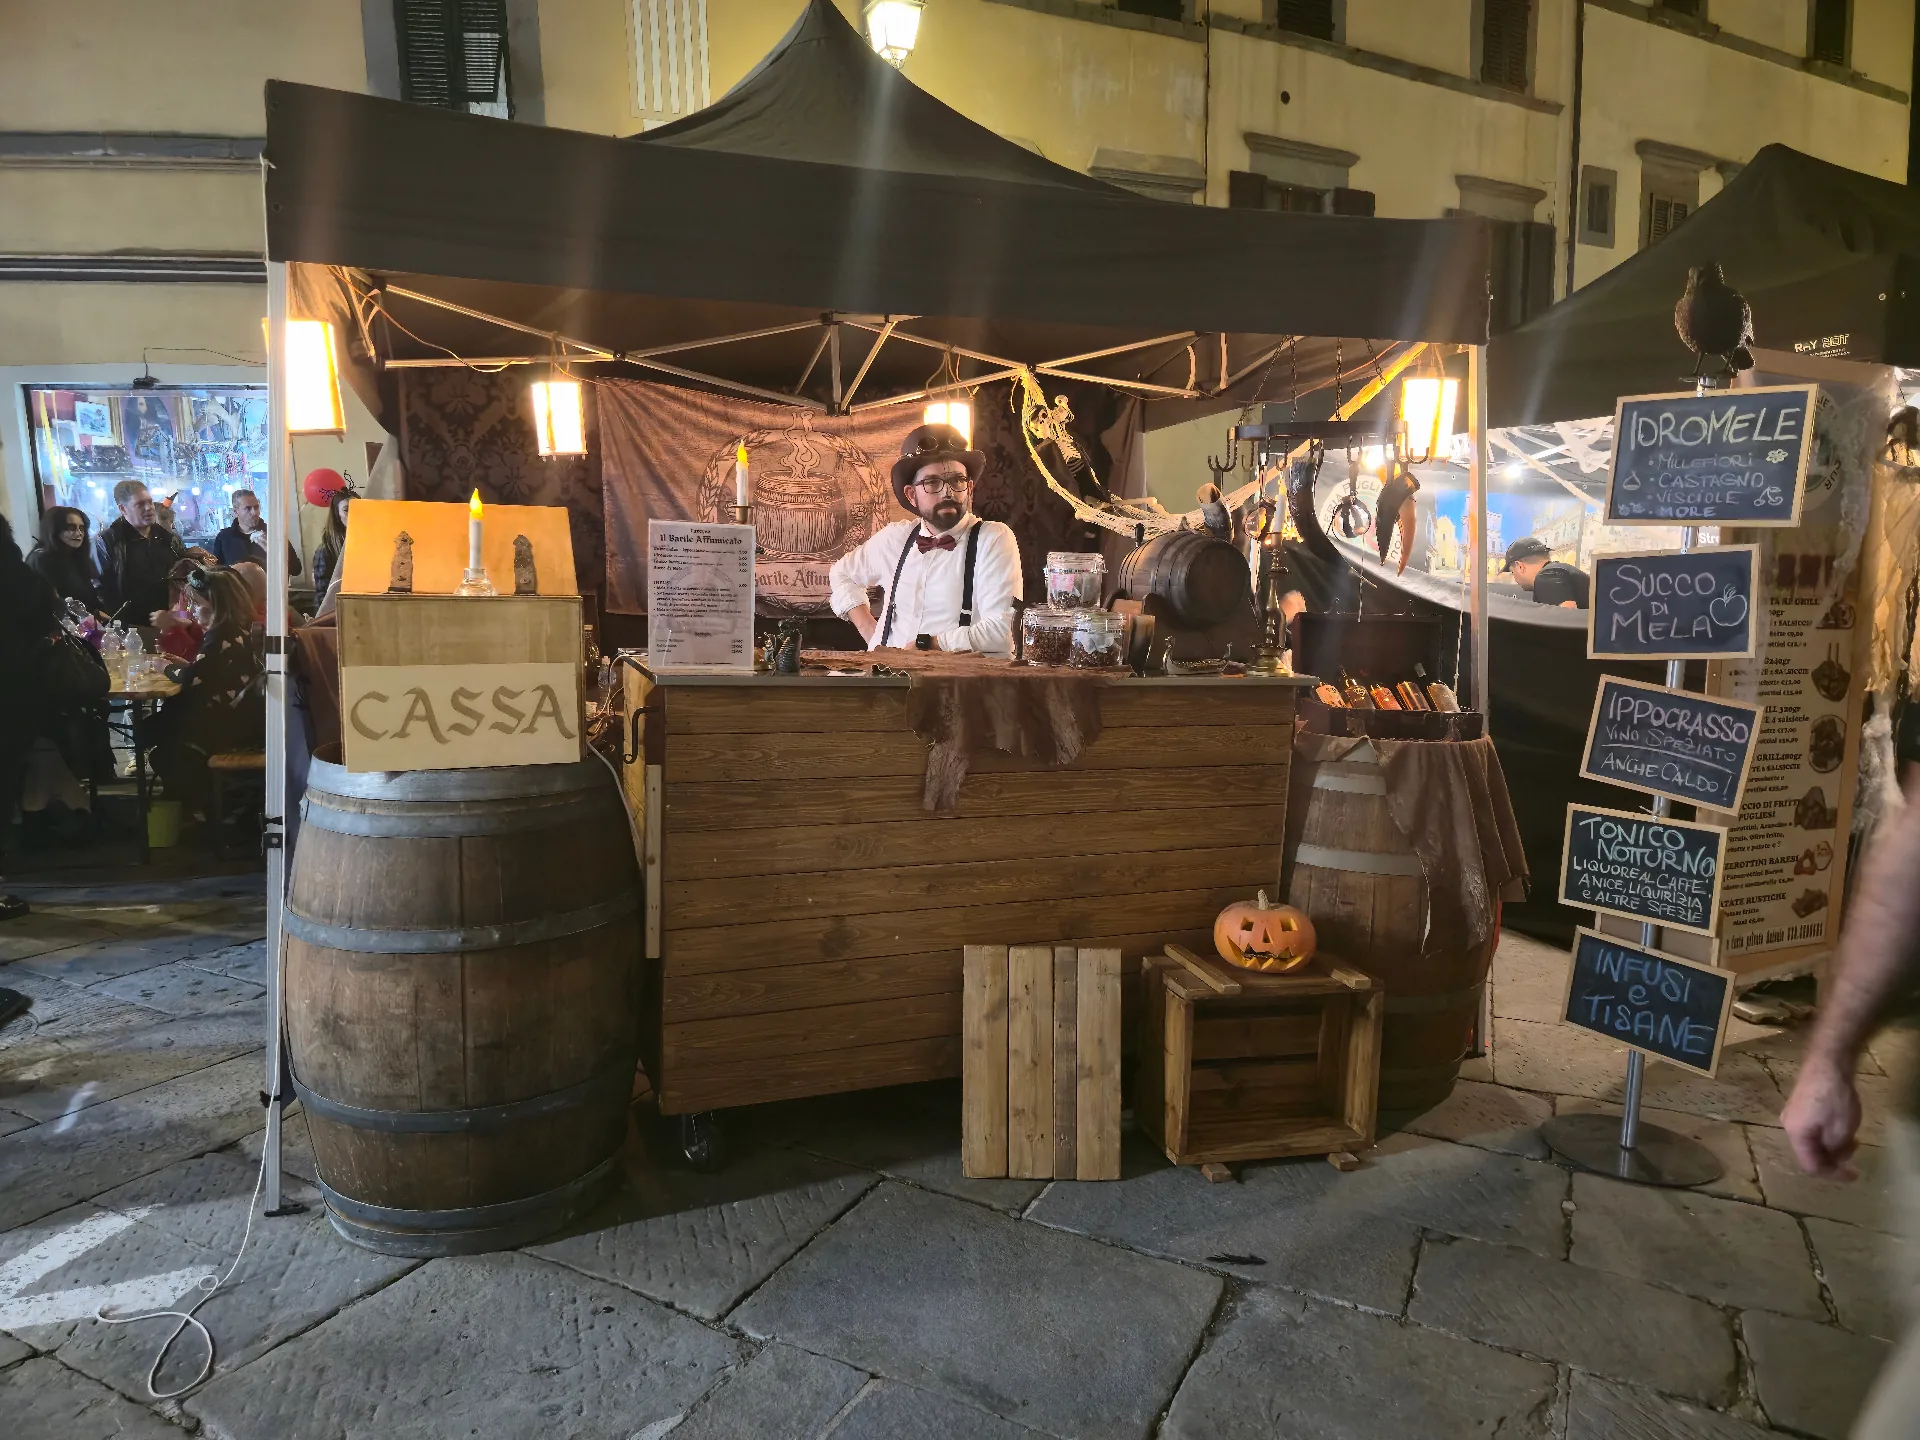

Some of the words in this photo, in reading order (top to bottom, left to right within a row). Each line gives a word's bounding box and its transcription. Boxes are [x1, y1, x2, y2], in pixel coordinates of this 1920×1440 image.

[1630, 405, 1800, 450] IDROMELE
[1659, 472, 1764, 488] CASTAGNO
[1660, 506, 1717, 518] MORE
[669, 534, 693, 543] Barile
[695, 535, 743, 545] Affumicato
[1609, 564, 1716, 605] SUCCO
[1610, 609, 1714, 644] MELA
[350, 684, 577, 745] CASSA
[1608, 691, 1749, 743] IPPOCRASSO
[1605, 724, 1640, 742] VINO
[1645, 728, 1737, 762] SPEZIATO
[1600, 751, 1658, 779] ANCHE
[1579, 815, 1685, 850] TONICO
[1573, 855, 1640, 880] LIQUORE
[1639, 871, 1656, 889] AL
[1597, 838, 1717, 877] NOTTURNO
[1595, 891, 1640, 911] ALTRE
[1647, 899, 1704, 924] SPEZIE
[1628, 883, 1703, 911] LIQUIRIZIA
[1746, 893, 1787, 904] RUSTICHE
[1595, 948, 1692, 1004] INFUSI
[1582, 994, 1715, 1055] TISANE
